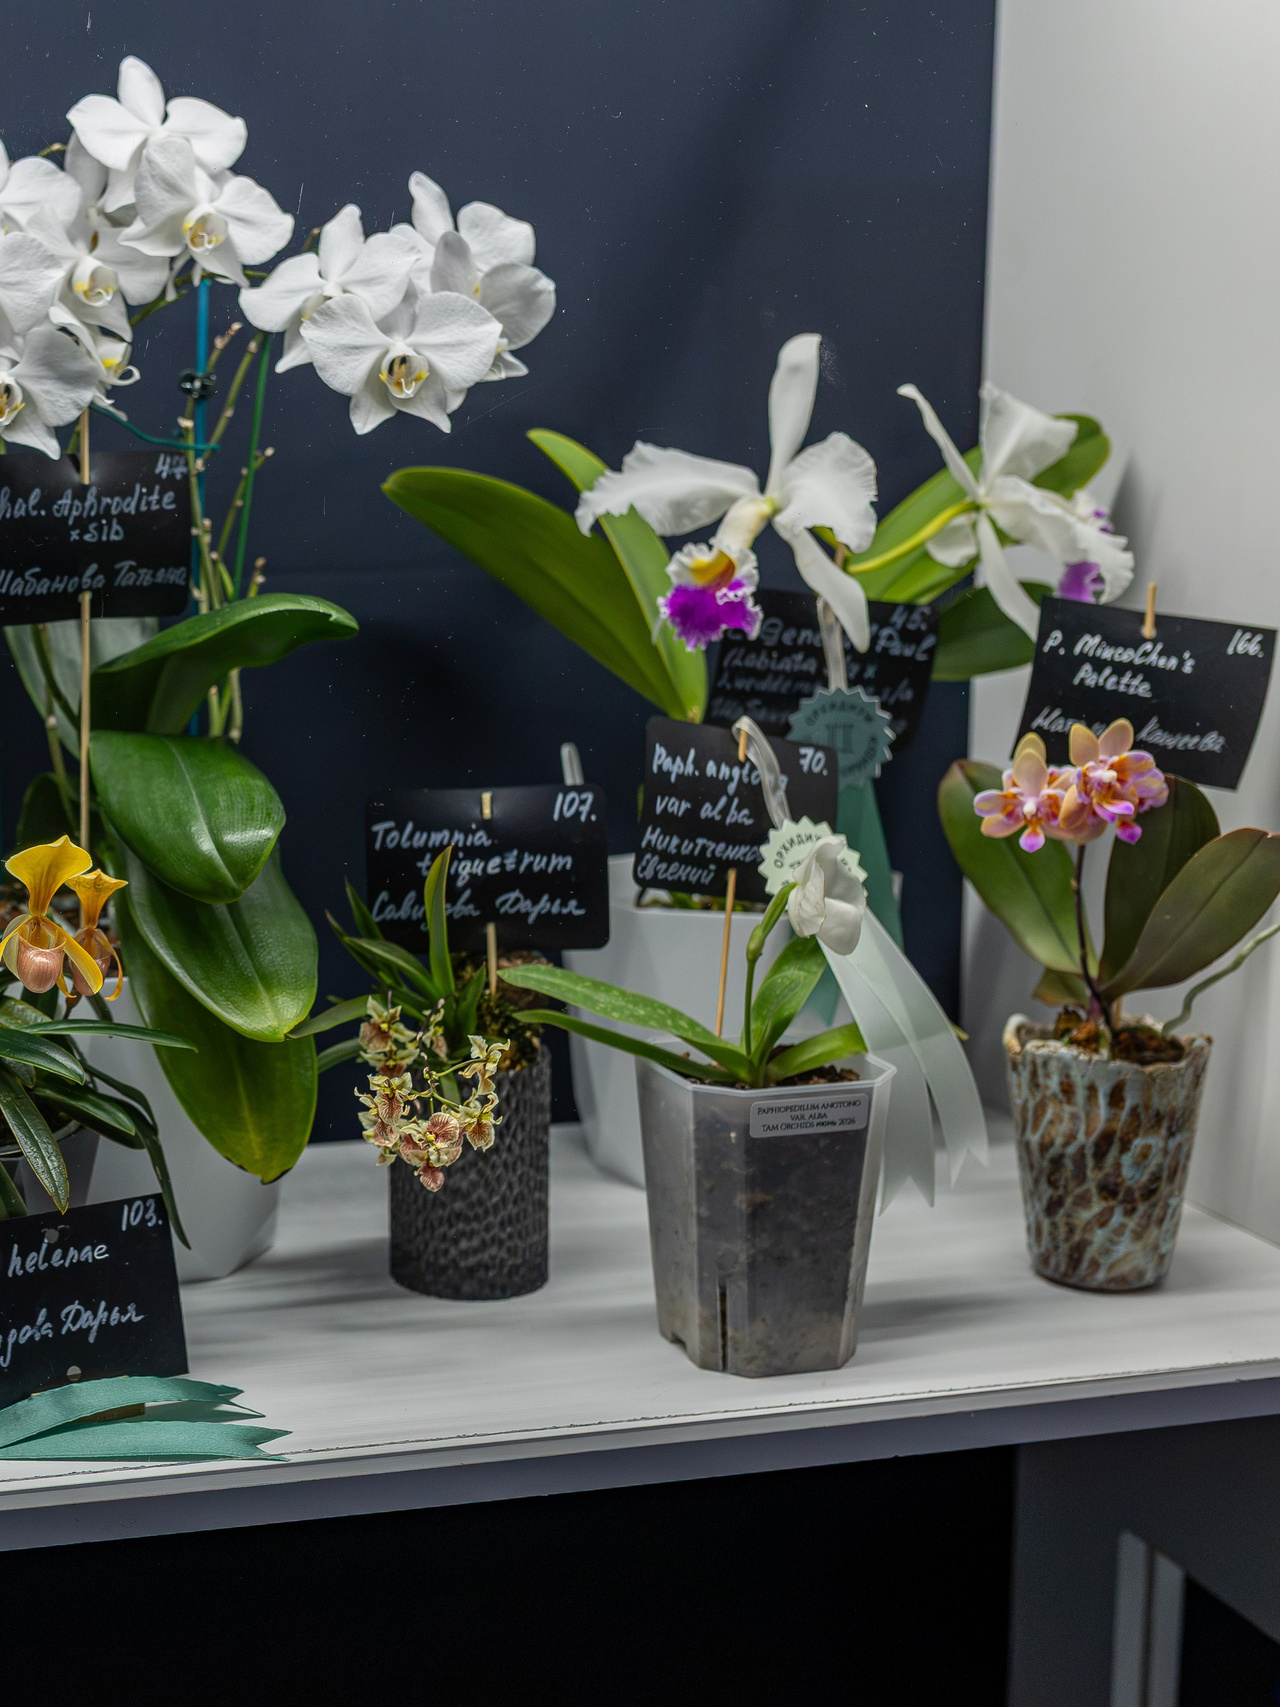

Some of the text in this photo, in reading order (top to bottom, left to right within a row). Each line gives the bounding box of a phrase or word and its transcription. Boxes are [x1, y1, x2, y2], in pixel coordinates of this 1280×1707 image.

[52, 483, 177, 525] Aphrodite
[113, 559, 188, 588] Татьяна
[1072, 662, 1153, 698] Palette
[798, 746, 829, 776] 70.
[552, 790, 598, 822] 107.
[655, 794, 692, 819] var
[636, 852, 717, 886] Евгений
[494, 887, 587, 925] Дарья
[120, 1197, 163, 1232] 103.
[60, 1300, 147, 1345] Дарья
